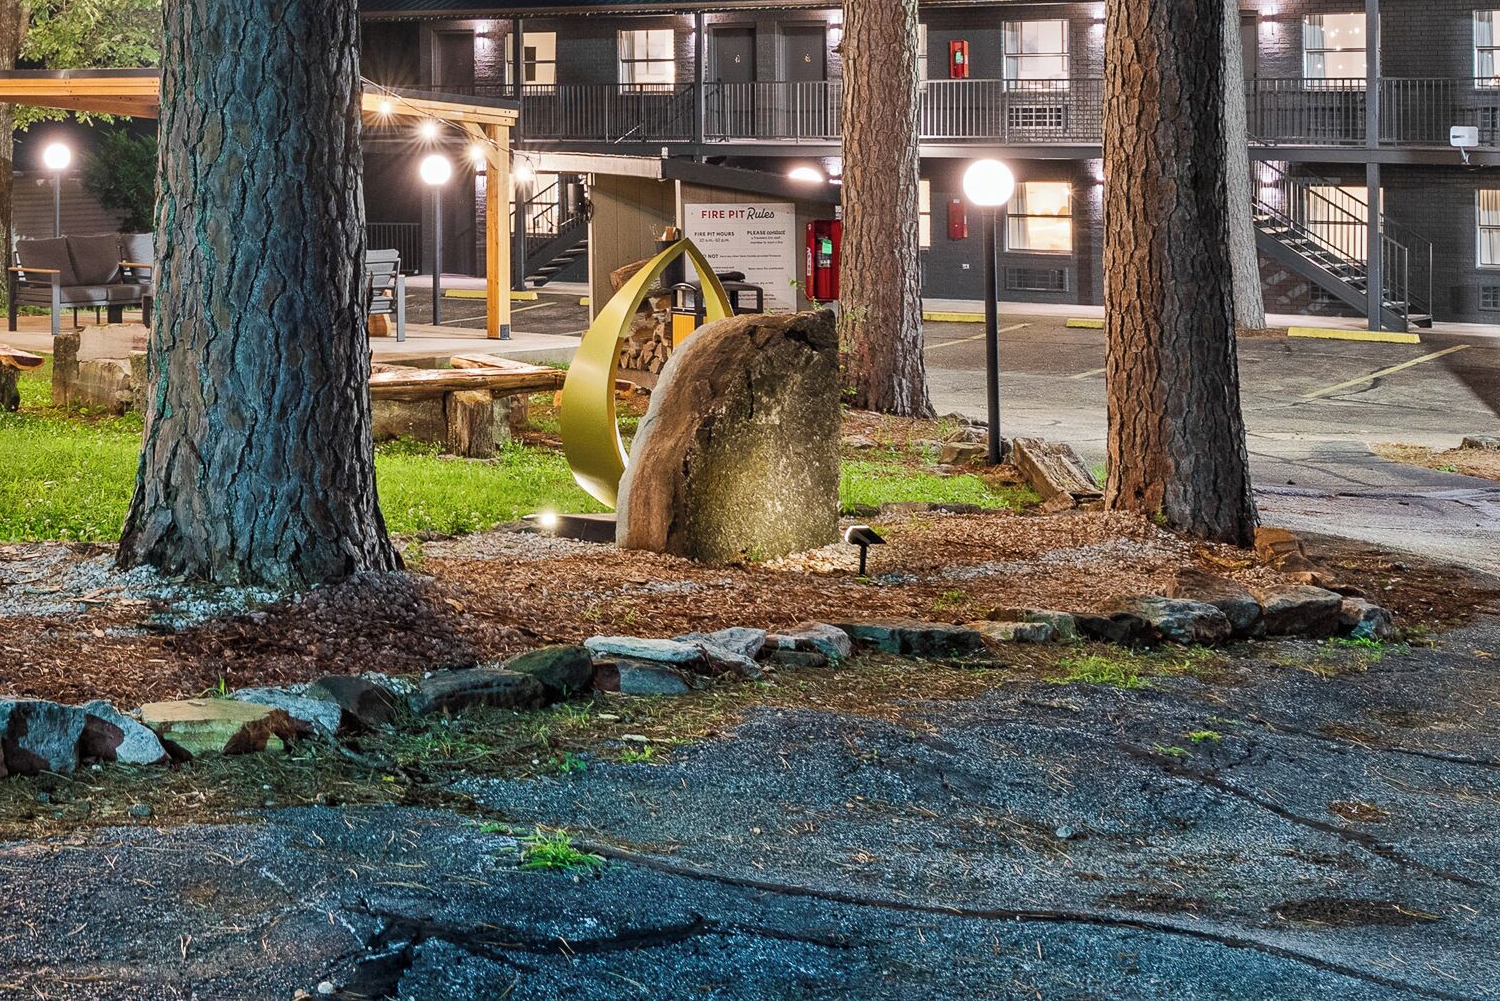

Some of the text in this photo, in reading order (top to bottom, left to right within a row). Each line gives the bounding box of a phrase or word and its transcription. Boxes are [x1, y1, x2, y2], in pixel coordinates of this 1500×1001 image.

[701, 207, 775, 220] FIRE PIT Rules
